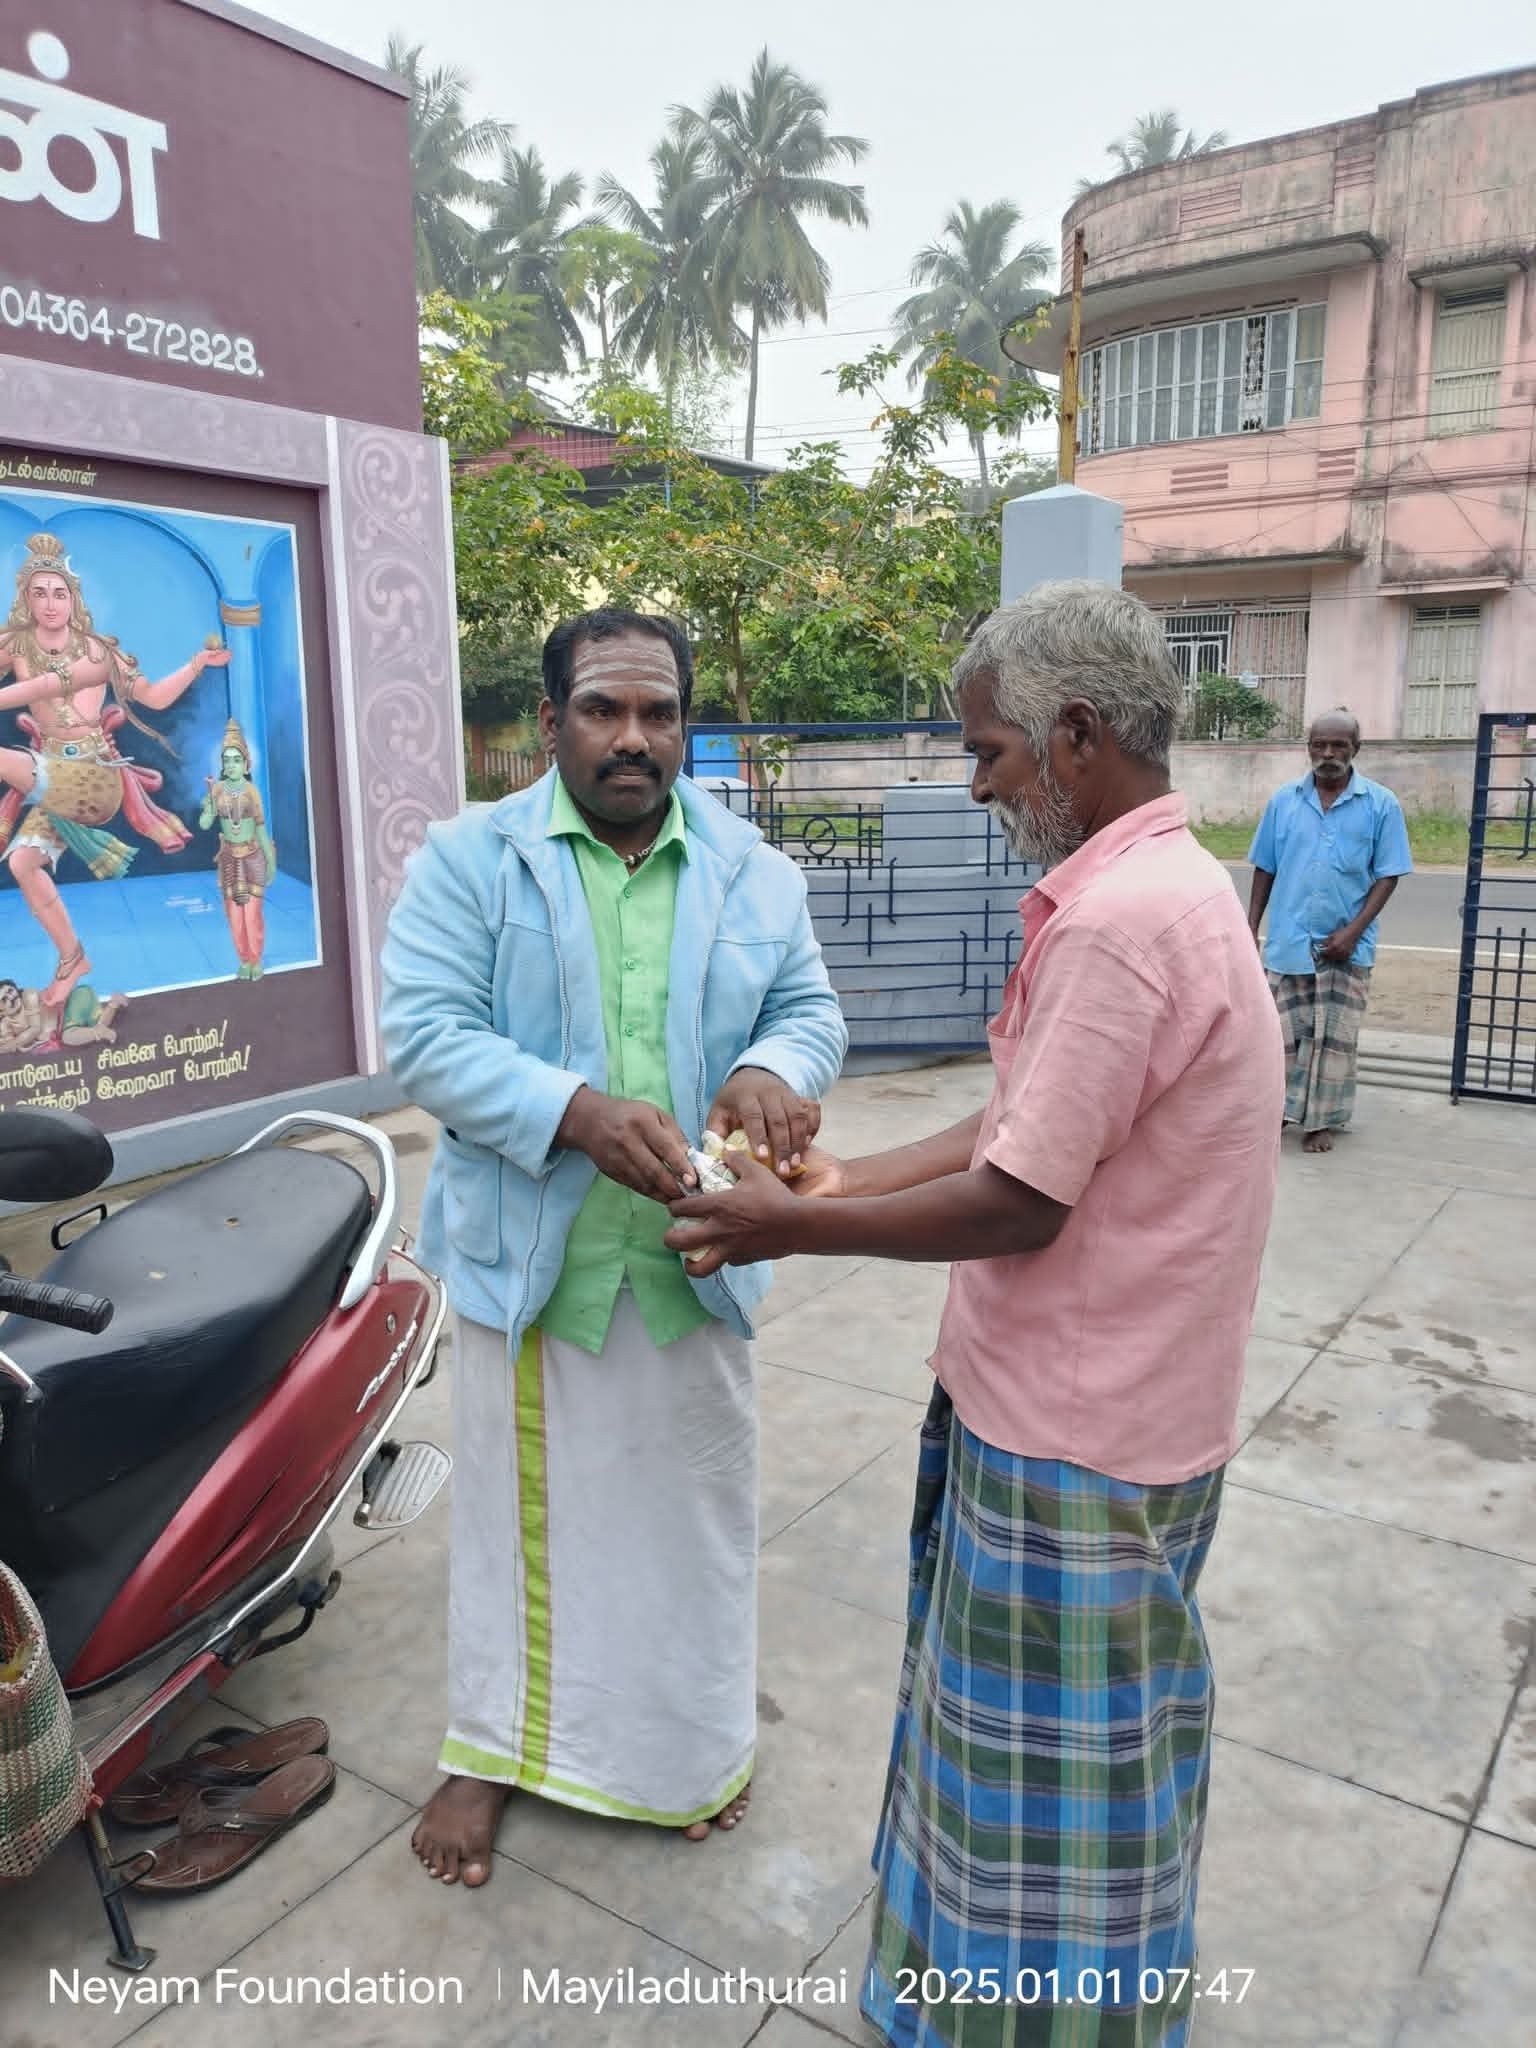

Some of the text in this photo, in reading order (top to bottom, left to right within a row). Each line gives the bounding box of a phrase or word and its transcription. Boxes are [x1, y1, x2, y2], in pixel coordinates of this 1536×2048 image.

[0, 284, 264, 378] 04364-272828.
[97, 1042, 157, 1070] சிவனே
[163, 1019, 228, 1057] போற்றி!
[96, 1068, 176, 1100] இறைவா
[184, 1045, 251, 1081] போற்றி!
